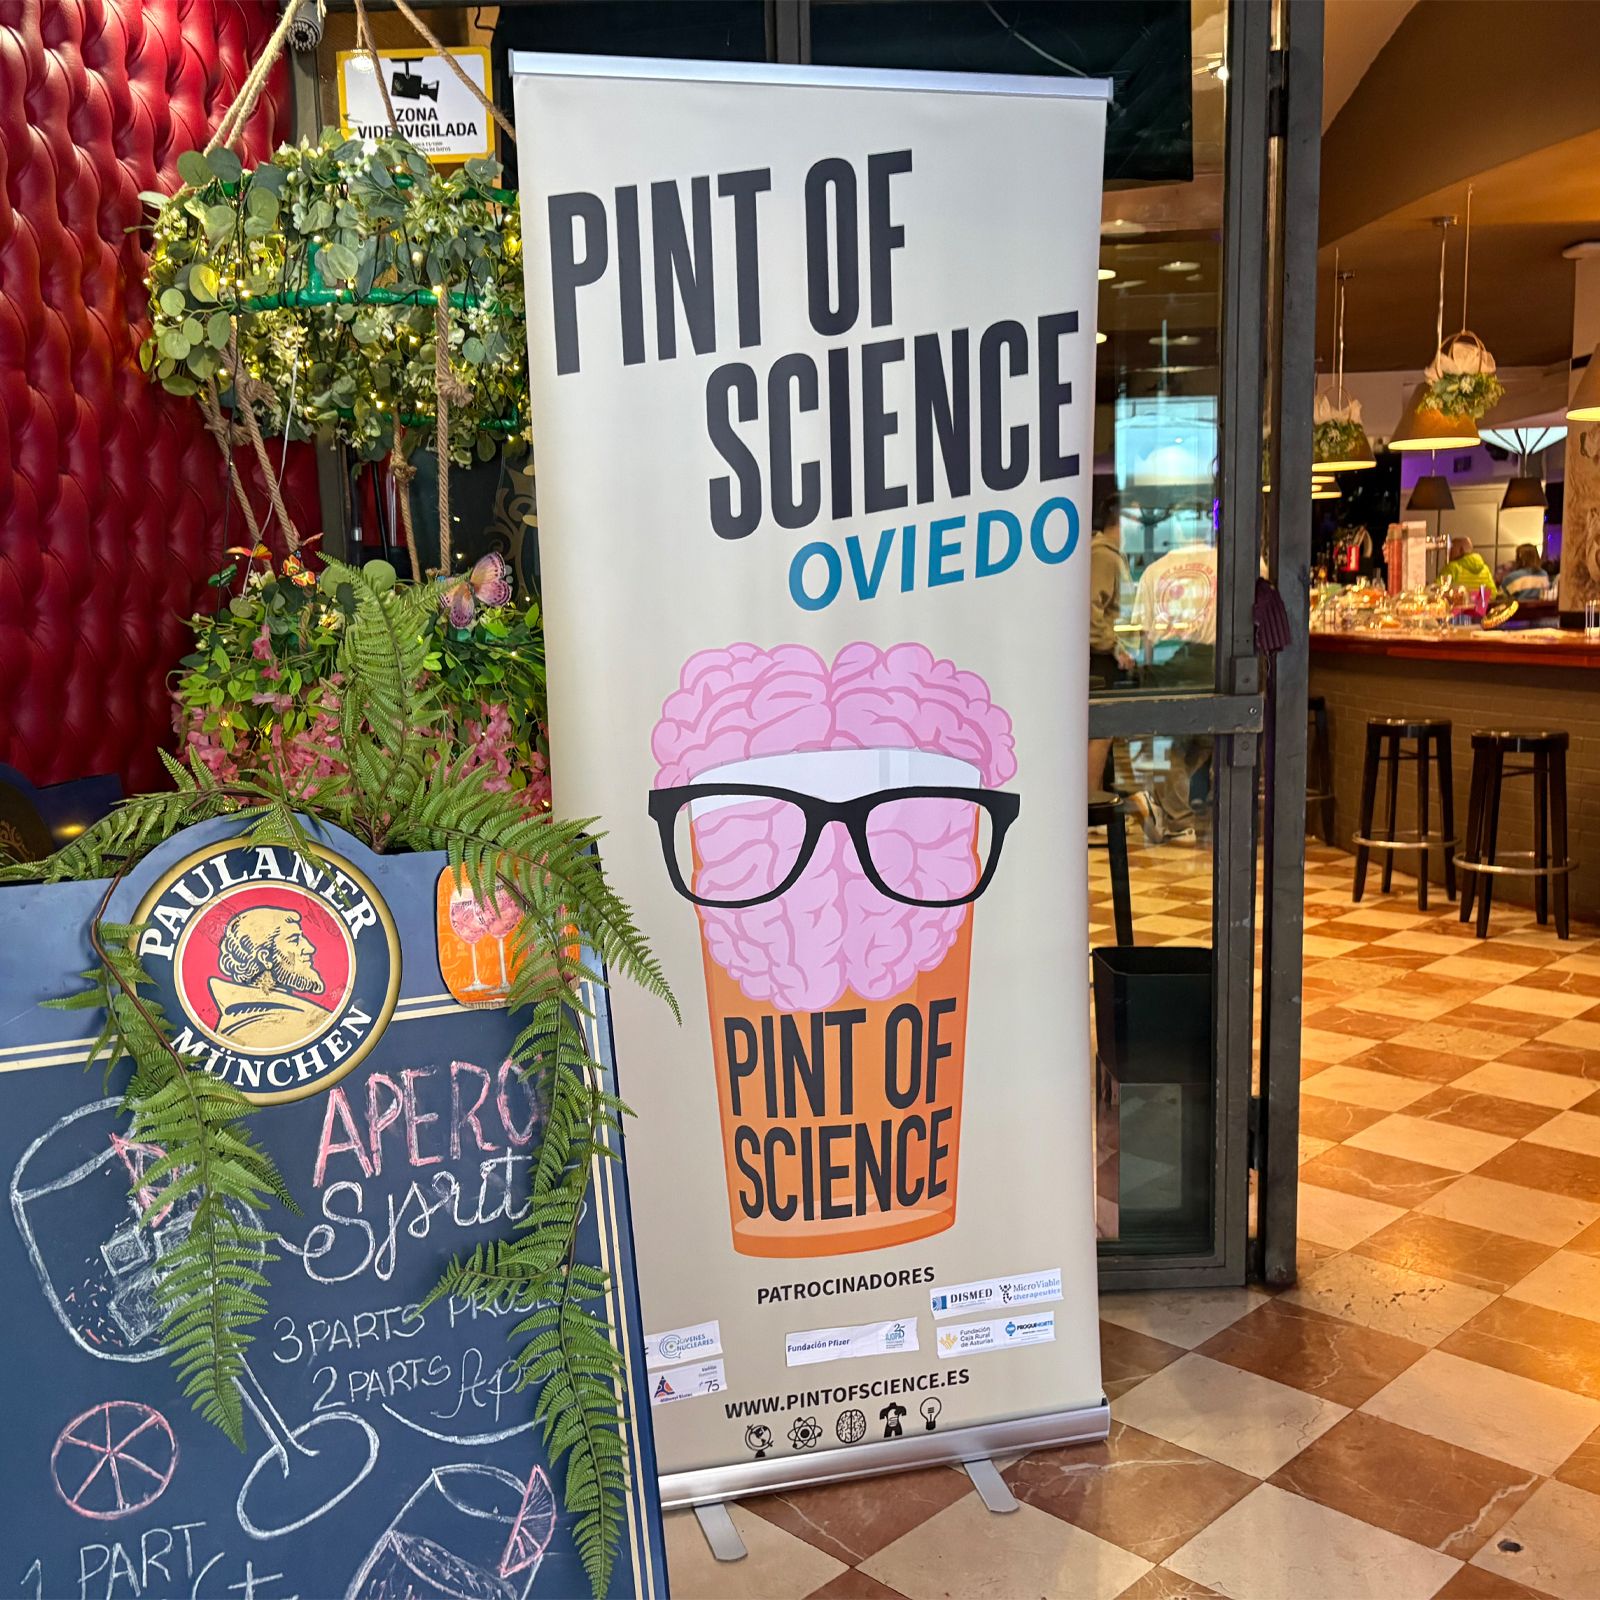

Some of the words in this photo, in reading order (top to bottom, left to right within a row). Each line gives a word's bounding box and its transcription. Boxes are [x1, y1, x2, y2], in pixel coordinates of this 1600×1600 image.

[395, 107, 438, 122] ZONA
[547, 167, 772, 377] PINT
[804, 148, 913, 337] OF
[705, 310, 1080, 540] SCIENCE
[788, 496, 1080, 611] OVIEDO
[139, 846, 377, 960] PAULANER
[169, 1004, 373, 1088] MÜNCHEN
[723, 1007, 867, 1118] PINT
[884, 997, 957, 1109] OF
[734, 1105, 953, 1222] SCIENCE
[757, 1266, 936, 1305] PATROCINADORES
[950, 1288, 993, 1303] DISMED
[1013, 1278, 1060, 1292] MicroViable
[1013, 1288, 1060, 1301] therapeutics
[307, 1303, 426, 1356] PARTS
[676, 1338, 714, 1351] NUCLEARES
[787, 1340, 827, 1353] Fundación
[828, 1338, 850, 1348] Pfizer
[960, 1325, 991, 1336] Fundación
[960, 1334, 974, 1342] Caja
[974, 1332, 990, 1340] Rural
[969, 1338, 994, 1347] Asturias
[312, 1366, 346, 1412] 2
[348, 1355, 451, 1403] PARTS
[704, 1379, 720, 1393] 75
[724, 1368, 970, 1419] WWW.PINTOFSCIENCE.ES
[77, 1521, 207, 1600] PART
